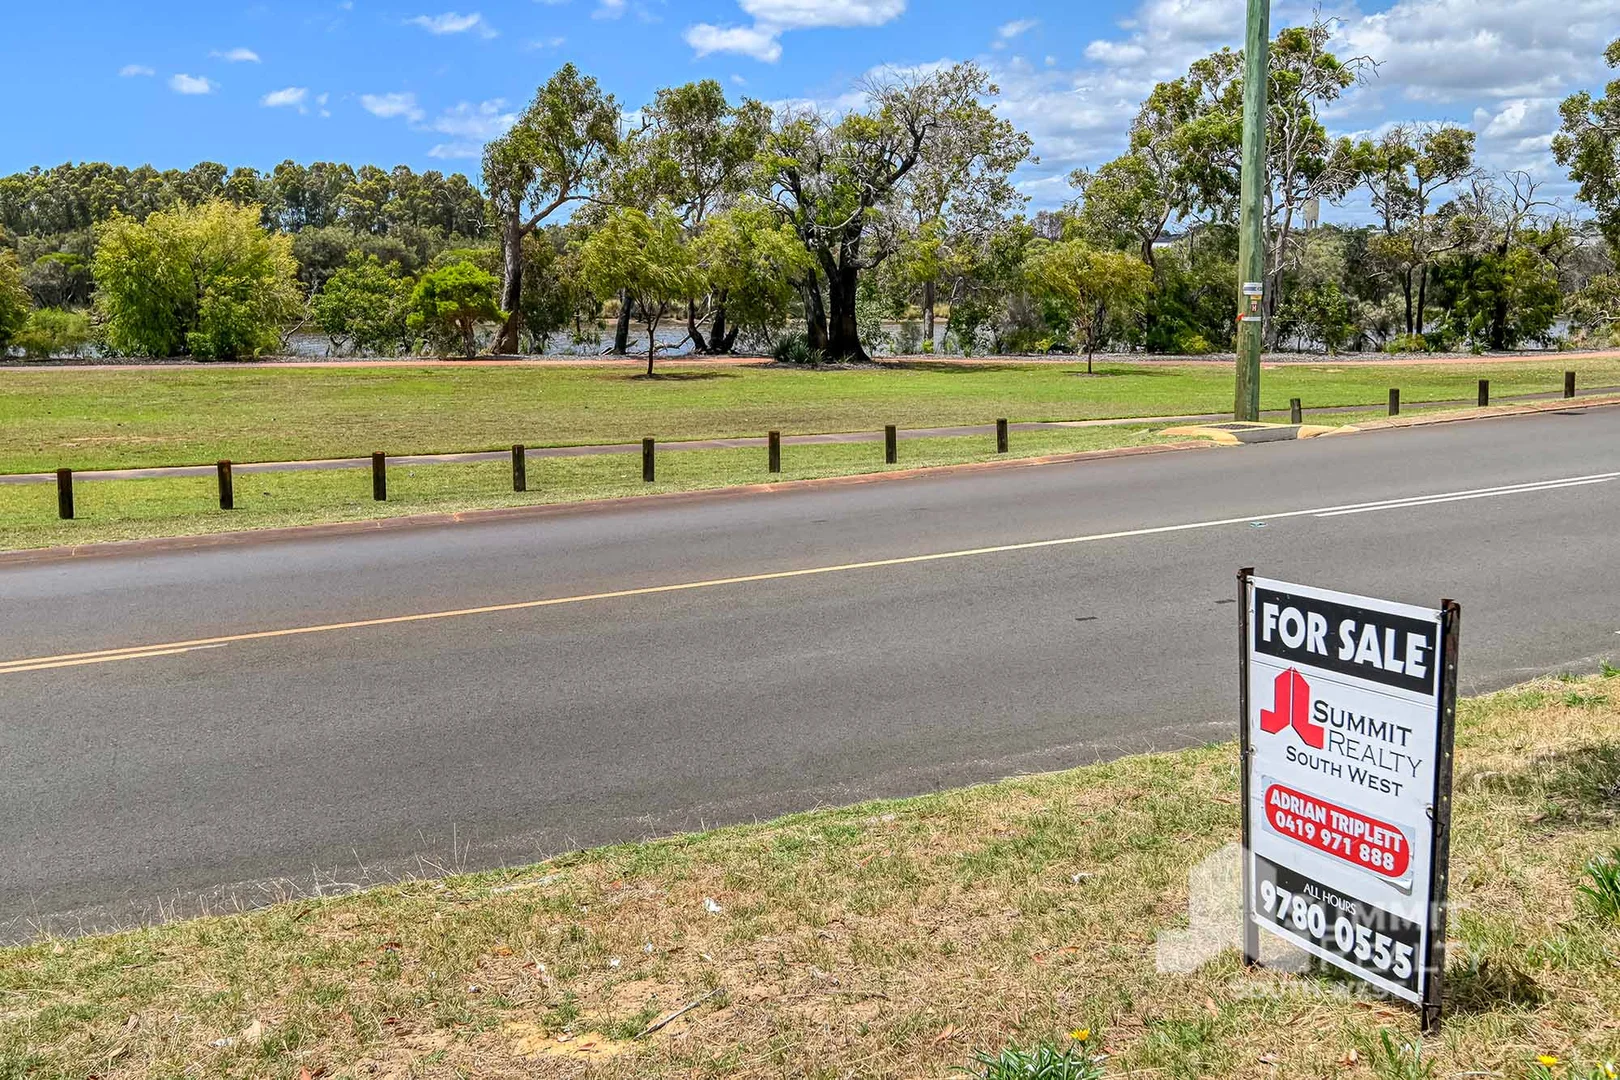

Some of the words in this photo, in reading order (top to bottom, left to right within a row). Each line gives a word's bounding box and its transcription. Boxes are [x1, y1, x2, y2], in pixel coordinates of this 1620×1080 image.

[1263, 602, 1329, 656] FOR
[1339, 619, 1428, 679] SALE
[1313, 700, 1412, 747] SUMMIT
[1286, 745, 1341, 778] SOUTH
[1347, 764, 1403, 797] WEST
[1328, 730, 1422, 778] REALTY
[1270, 789, 1326, 825] ADRIAN
[1330, 811, 1403, 852] TRIPLETT
[1275, 810, 1316, 839] 0419
[1320, 830, 1353, 856] 971
[1359, 844, 1395, 871] 888
[1303, 883, 1321, 900] ALL
[1322, 890, 1357, 915] HOURS
[1260, 880, 1326, 939] 9780
[1334, 916, 1413, 979] 0555
